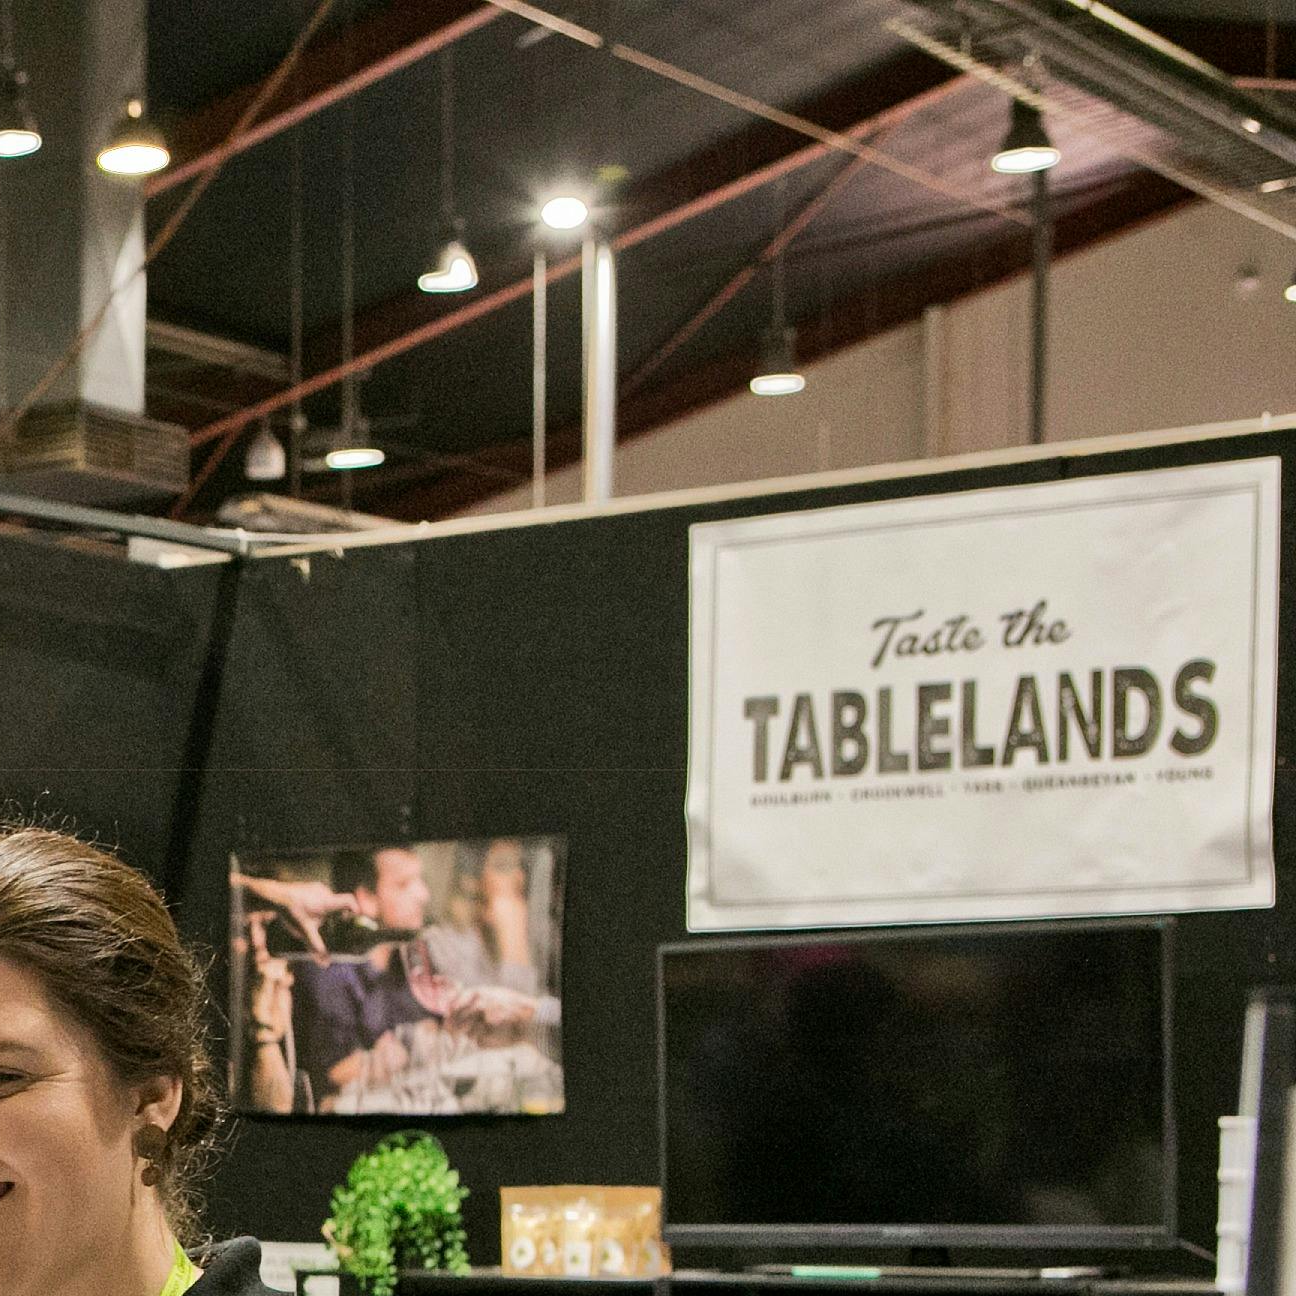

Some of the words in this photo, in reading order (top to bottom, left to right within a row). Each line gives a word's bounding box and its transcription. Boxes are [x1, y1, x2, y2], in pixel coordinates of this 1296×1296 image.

[871, 608, 986, 671] Taste
[1001, 599, 1072, 650] the
[743, 657, 1221, 784] TABLELANDS
